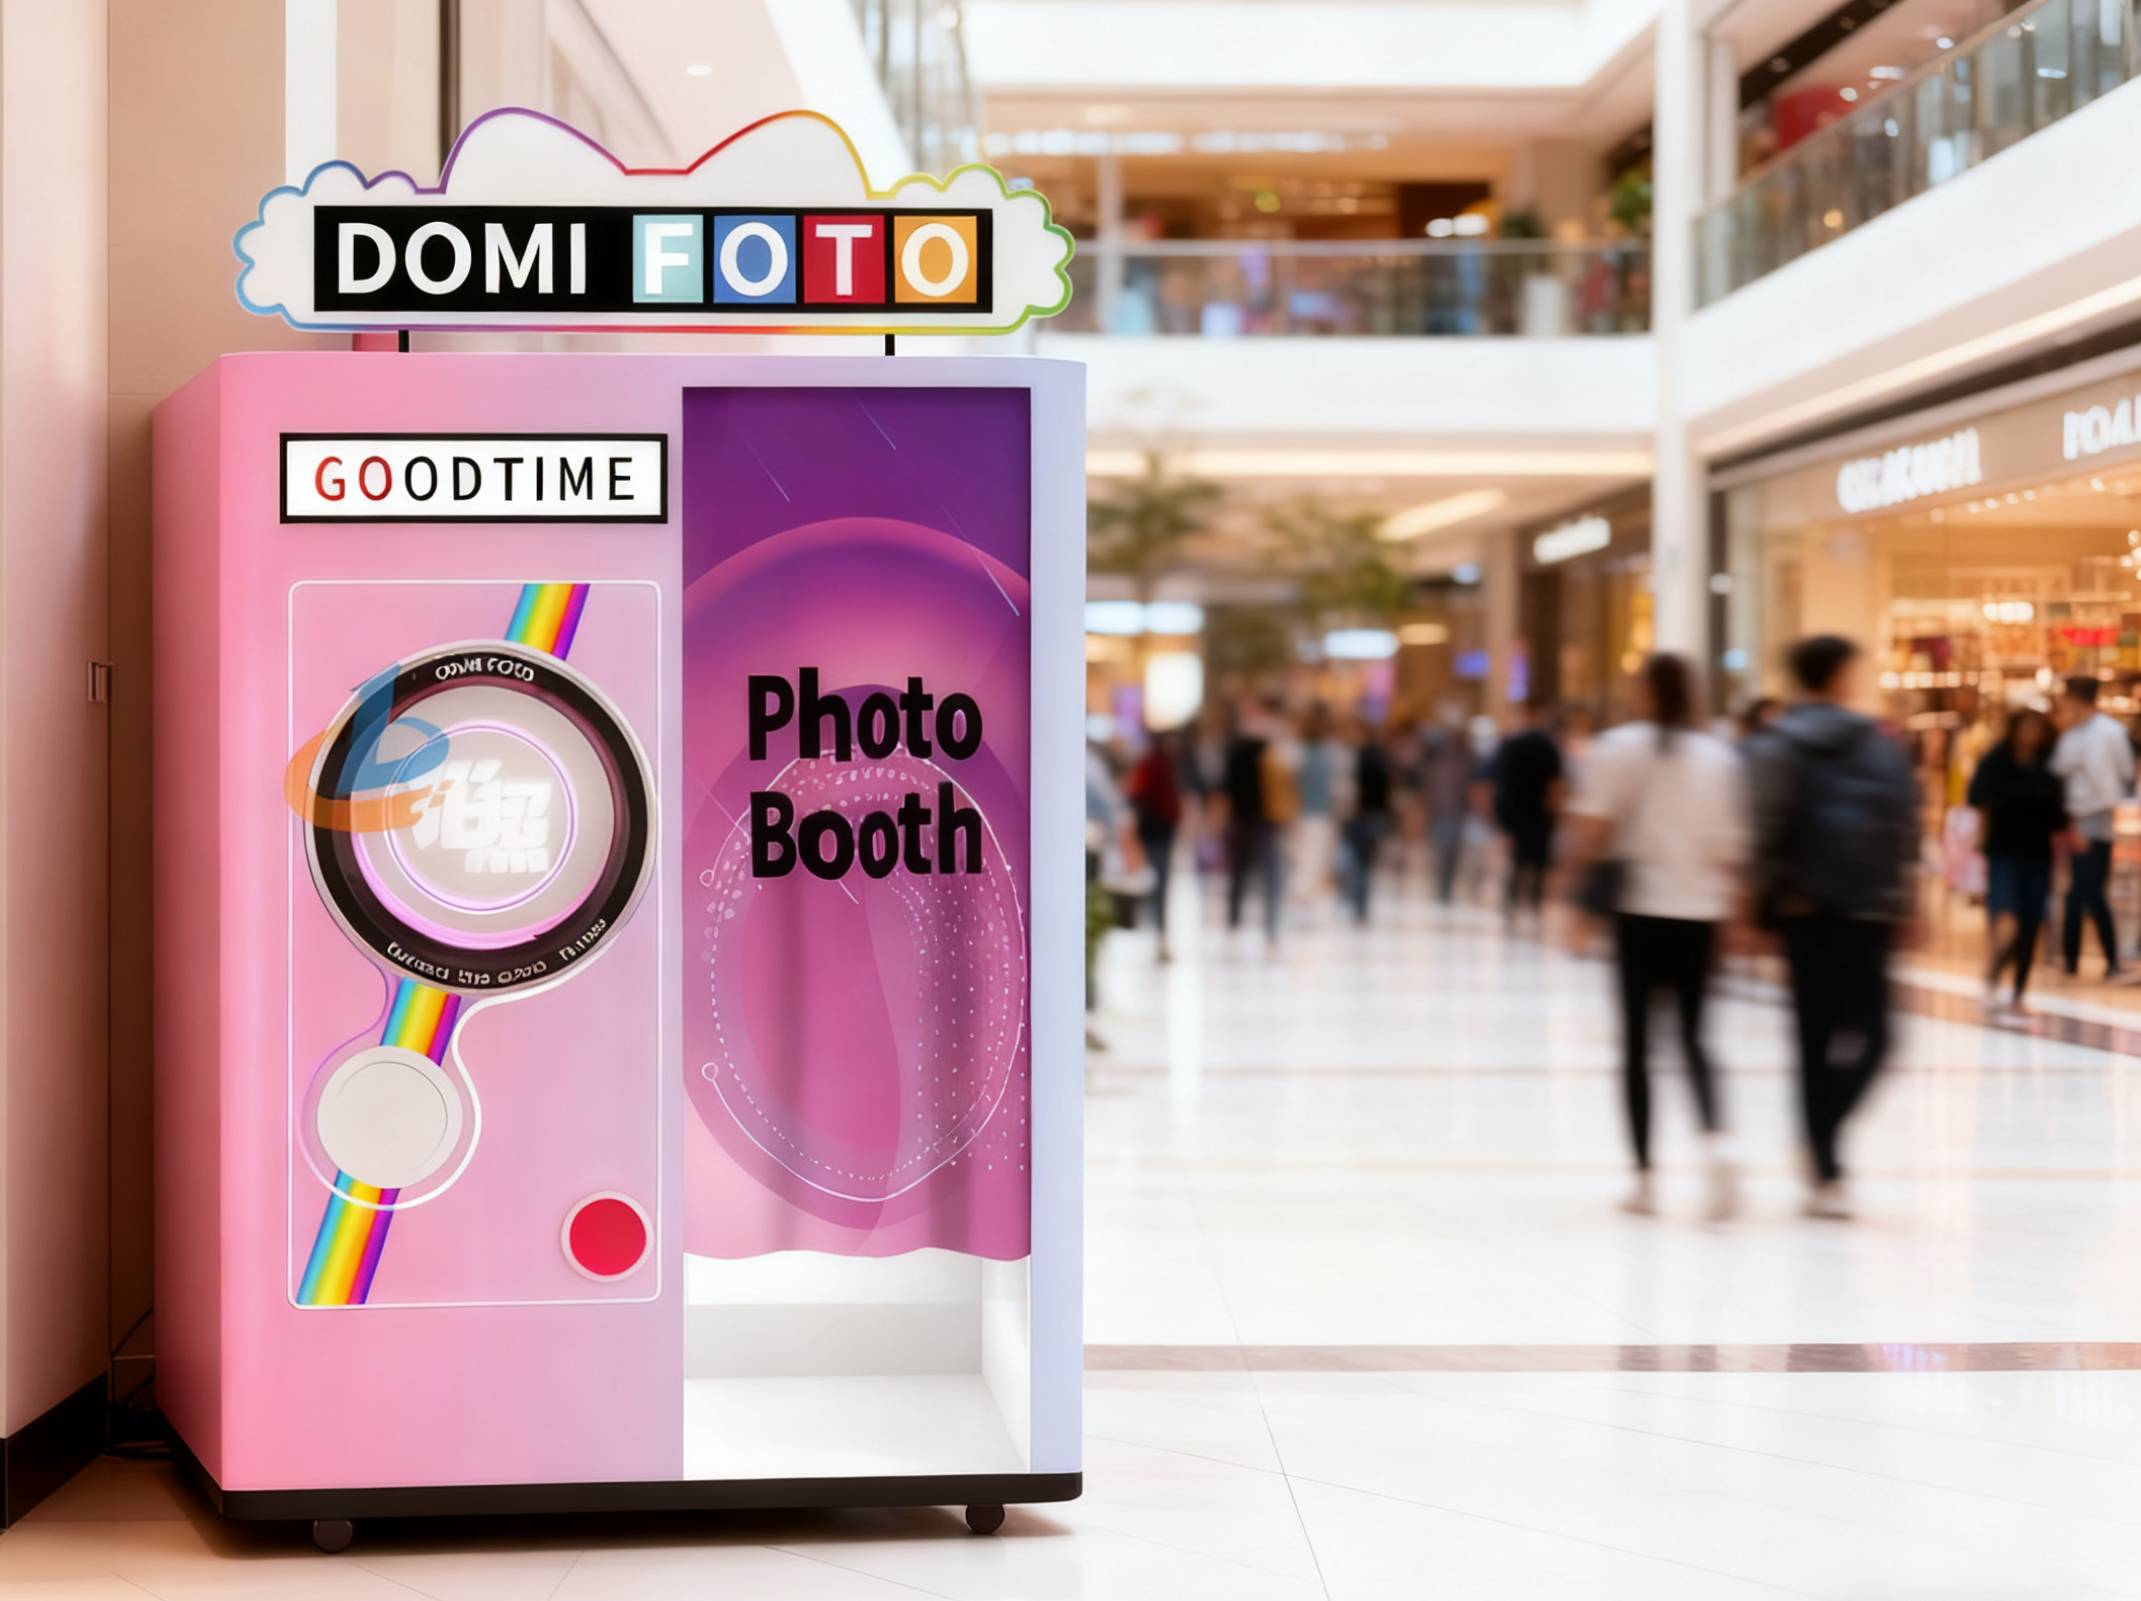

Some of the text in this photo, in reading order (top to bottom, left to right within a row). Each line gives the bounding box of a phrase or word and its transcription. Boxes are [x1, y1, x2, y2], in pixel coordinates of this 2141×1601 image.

[338, 221, 969, 297] DOMI FOTO
[314, 455, 635, 502] GOODTIME
[748, 667, 983, 762] Photo
[750, 781, 983, 881] Booth
